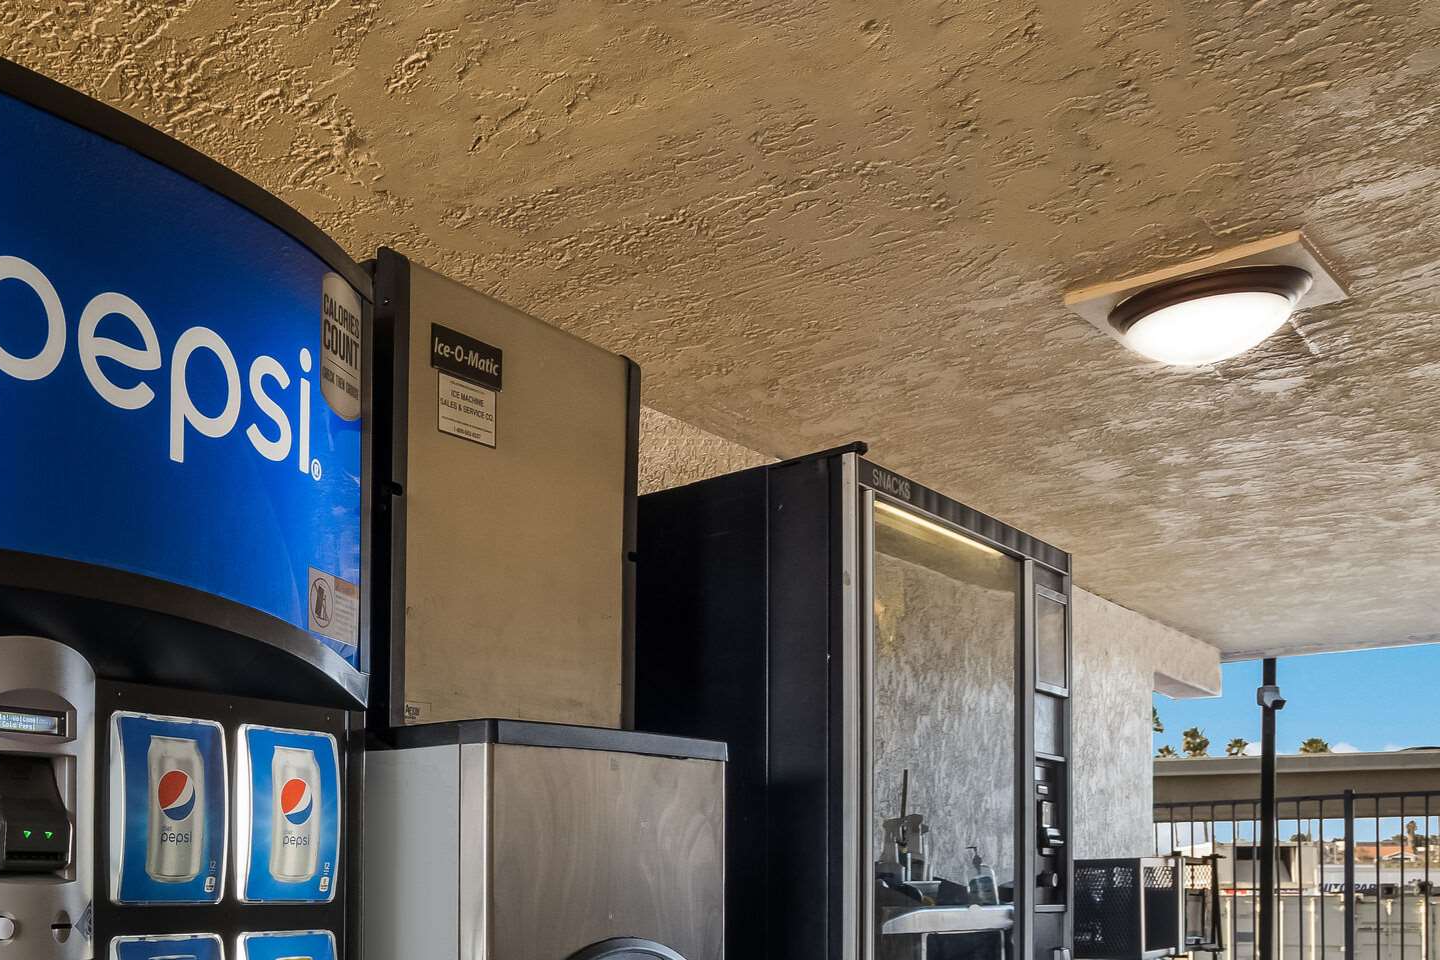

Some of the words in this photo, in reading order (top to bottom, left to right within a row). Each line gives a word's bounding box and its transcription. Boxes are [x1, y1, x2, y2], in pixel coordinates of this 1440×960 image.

[323, 293, 359, 338] CALORIES
[323, 318, 359, 370] COUNT
[433, 336, 499, 376] Ice-O-Matic
[872, 469, 911, 498] SNACKS
[160, 831, 193, 848] pepsi
[282, 834, 310, 849] pepsi
